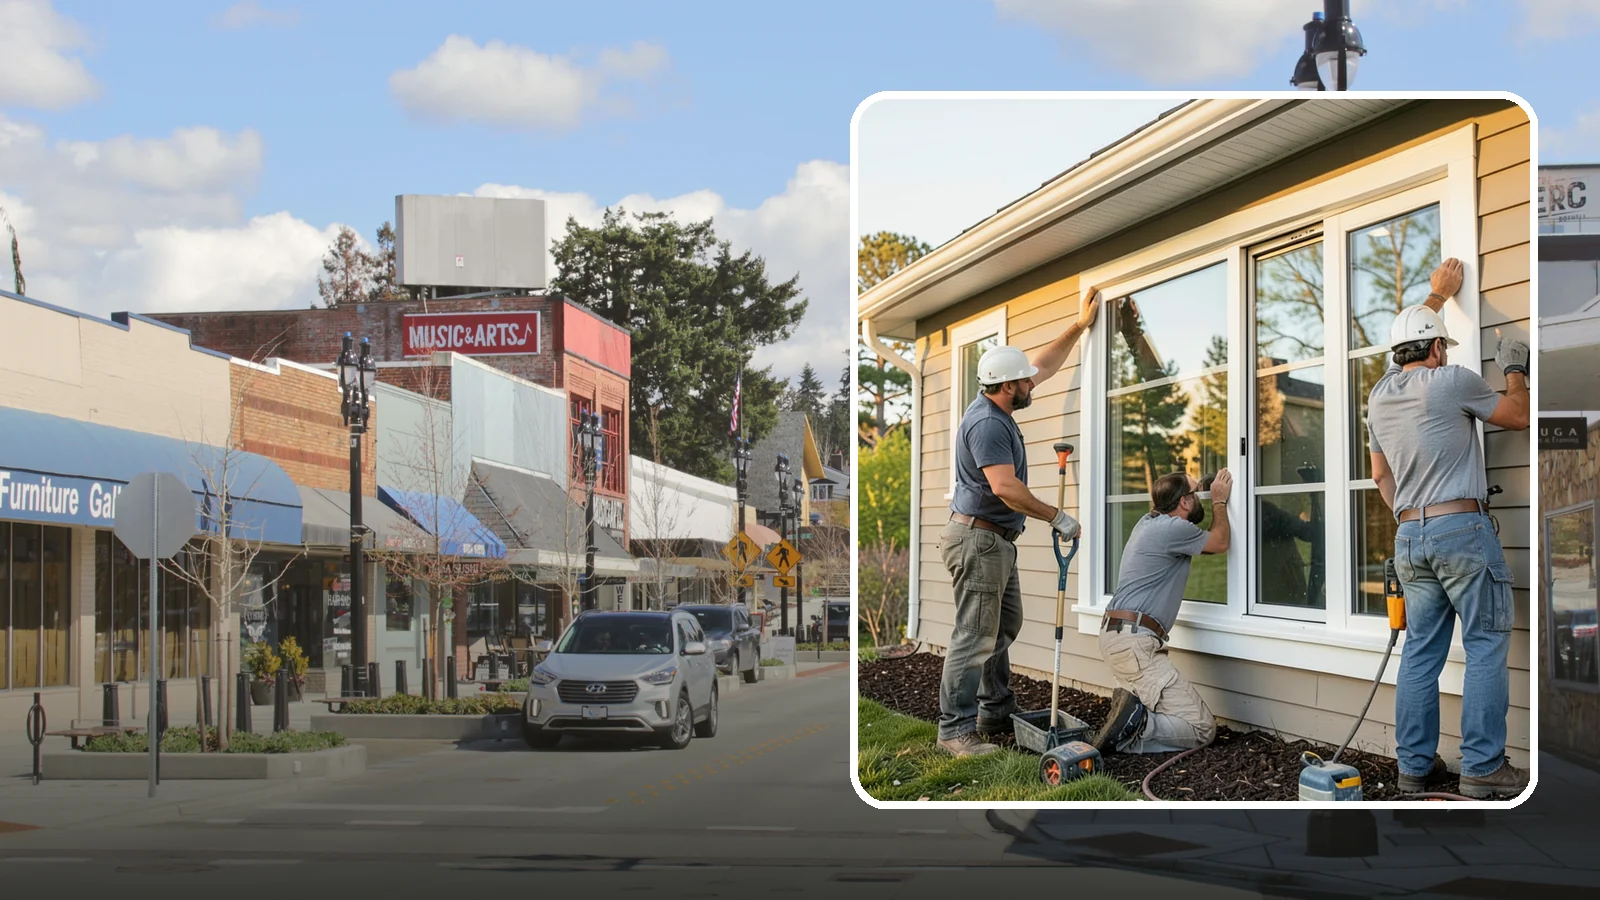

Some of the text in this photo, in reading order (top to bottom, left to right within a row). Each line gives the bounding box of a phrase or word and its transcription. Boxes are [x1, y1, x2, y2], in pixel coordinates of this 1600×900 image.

[409, 323, 519, 349] MUSIC&ARTS
[0, 472, 121, 519] Furniture Gal
[454, 563, 479, 574] SUSHI
